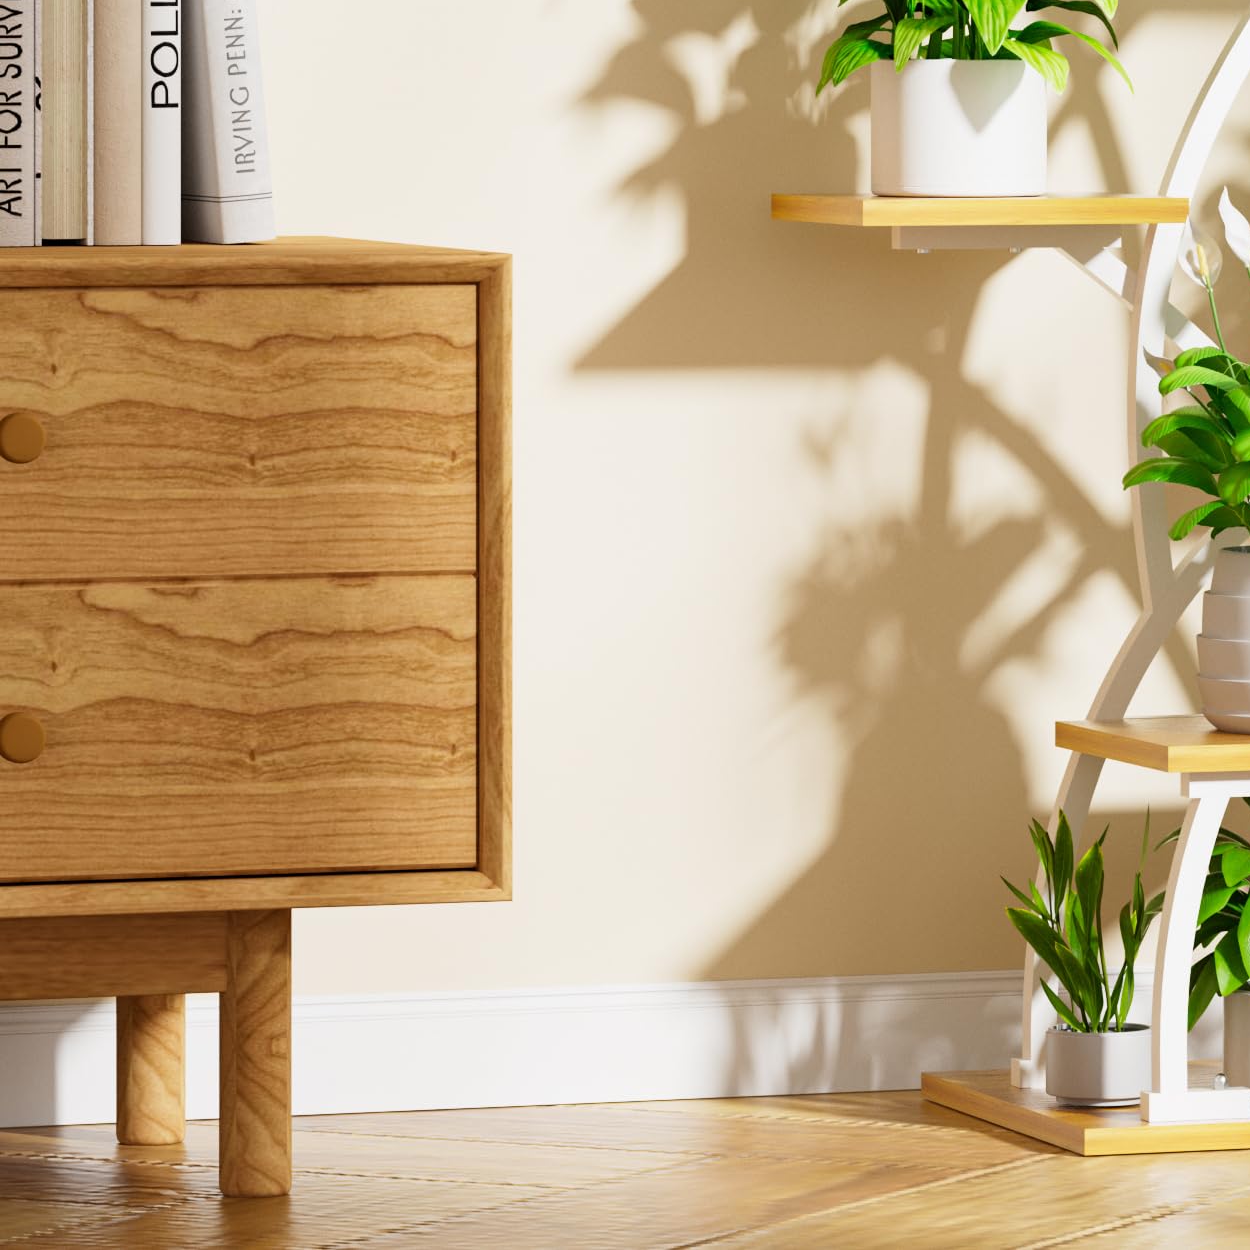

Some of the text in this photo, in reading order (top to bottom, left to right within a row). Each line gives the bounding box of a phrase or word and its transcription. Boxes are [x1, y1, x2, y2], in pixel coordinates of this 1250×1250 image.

[223, 8, 248, 76] PENN:
[0, 91, 23, 149] FOR
[230, 86, 256, 173] IRVING
